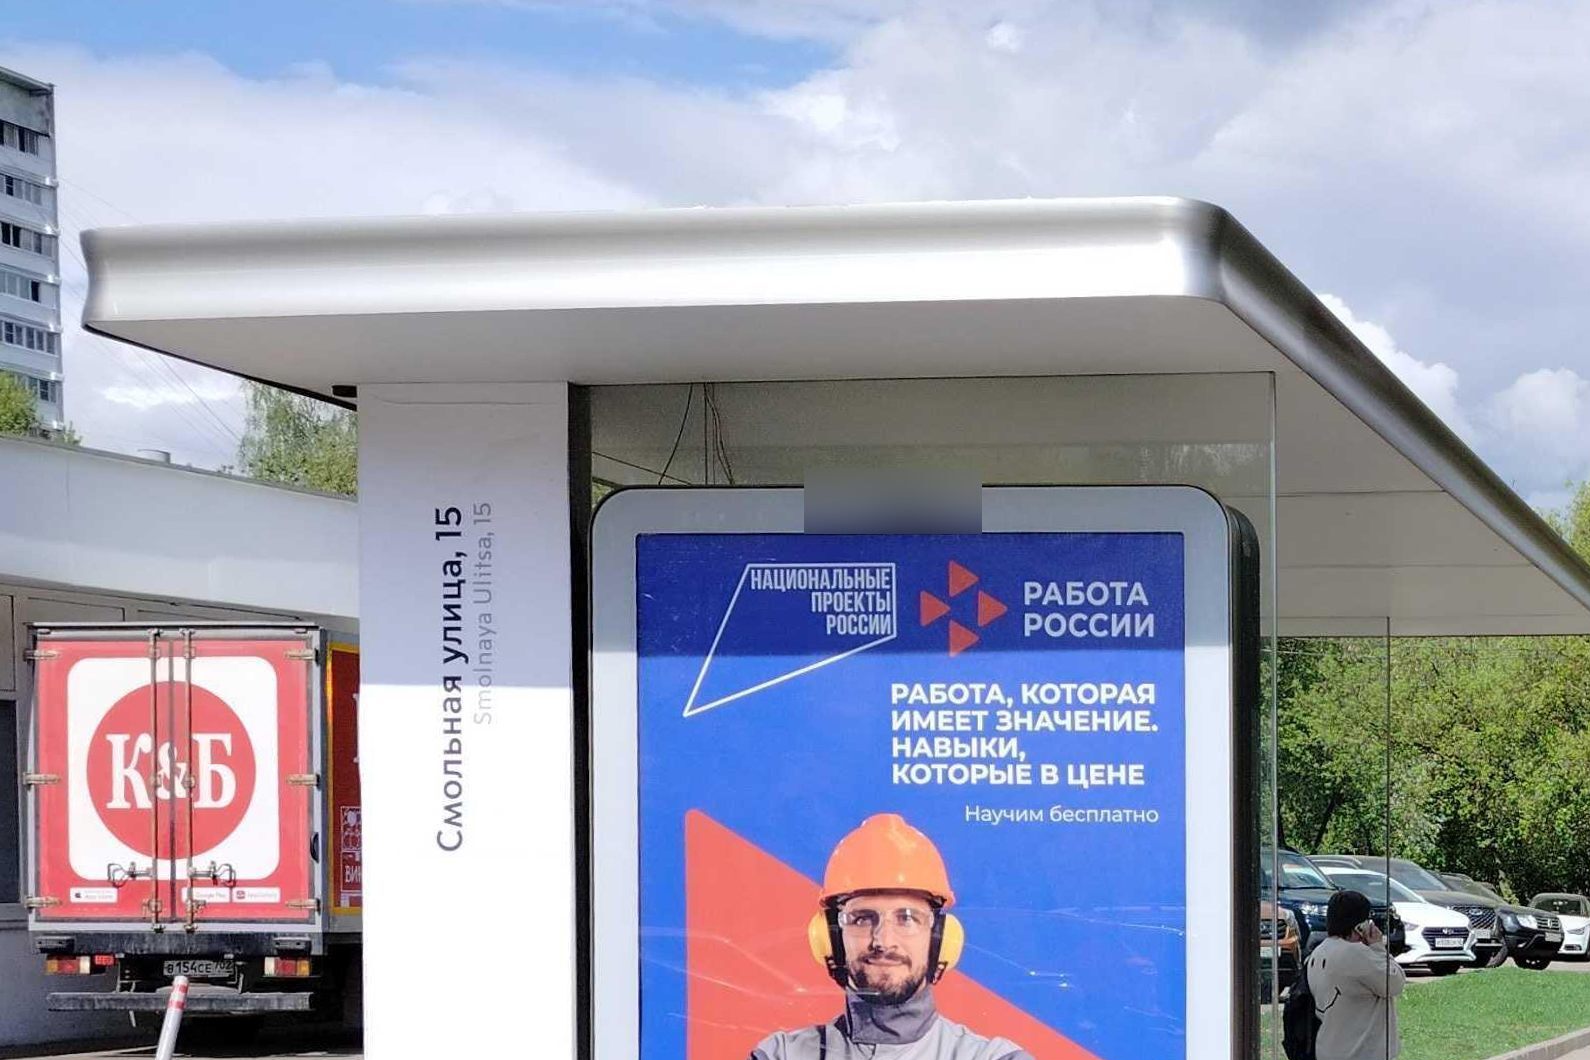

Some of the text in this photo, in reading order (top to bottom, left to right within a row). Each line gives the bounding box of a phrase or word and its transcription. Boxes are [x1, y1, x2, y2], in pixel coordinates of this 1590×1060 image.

[750, 568, 891, 593] НАЦИОНАЛЬНЫЕ
[811, 591, 891, 613] ПРОЕКТЫ
[1024, 581, 1149, 606] РАБОТА
[473, 502, 498, 726] Smolnaya Ulitsa, 15
[826, 614, 892, 635] РОССИИ
[1024, 612, 1155, 637] РОССИИ
[434, 505, 469, 852] Смольная улица, 15
[891, 683, 1156, 708] РАБОТА, КОТОРАЯ
[891, 710, 1159, 732] ИМЕЕТ ЗНАЧЕНИЕ.
[892, 737, 1026, 761] НАВЫКИ,
[104, 732, 238, 810] К&Б
[892, 764, 1145, 789] КОТОРЫЕ В ЦЕНЕ
[965, 805, 1159, 826] Научим бесплатно
